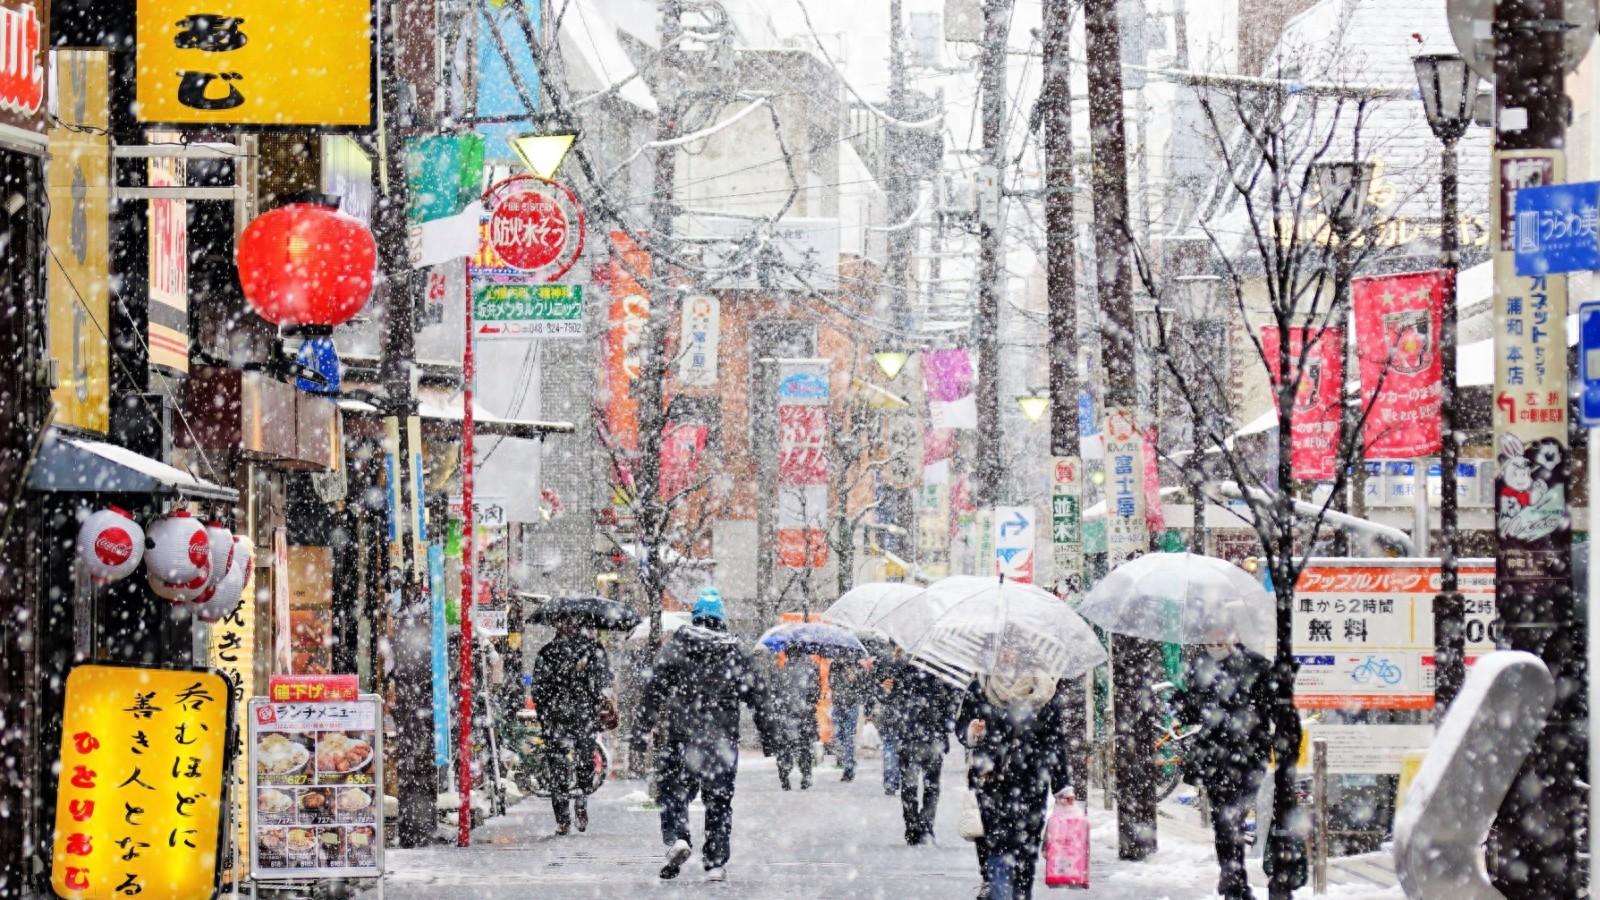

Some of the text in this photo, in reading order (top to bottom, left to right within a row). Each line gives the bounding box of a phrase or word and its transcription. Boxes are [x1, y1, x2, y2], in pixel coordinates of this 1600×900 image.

[1302, 572, 1421, 589] アップルパーク
[1297, 598, 1394, 614] 庫から2時間
[1308, 618, 1368, 642] 無料
[169, 682, 214, 849] 呑むほどに
[115, 692, 162, 895] 善き人となる
